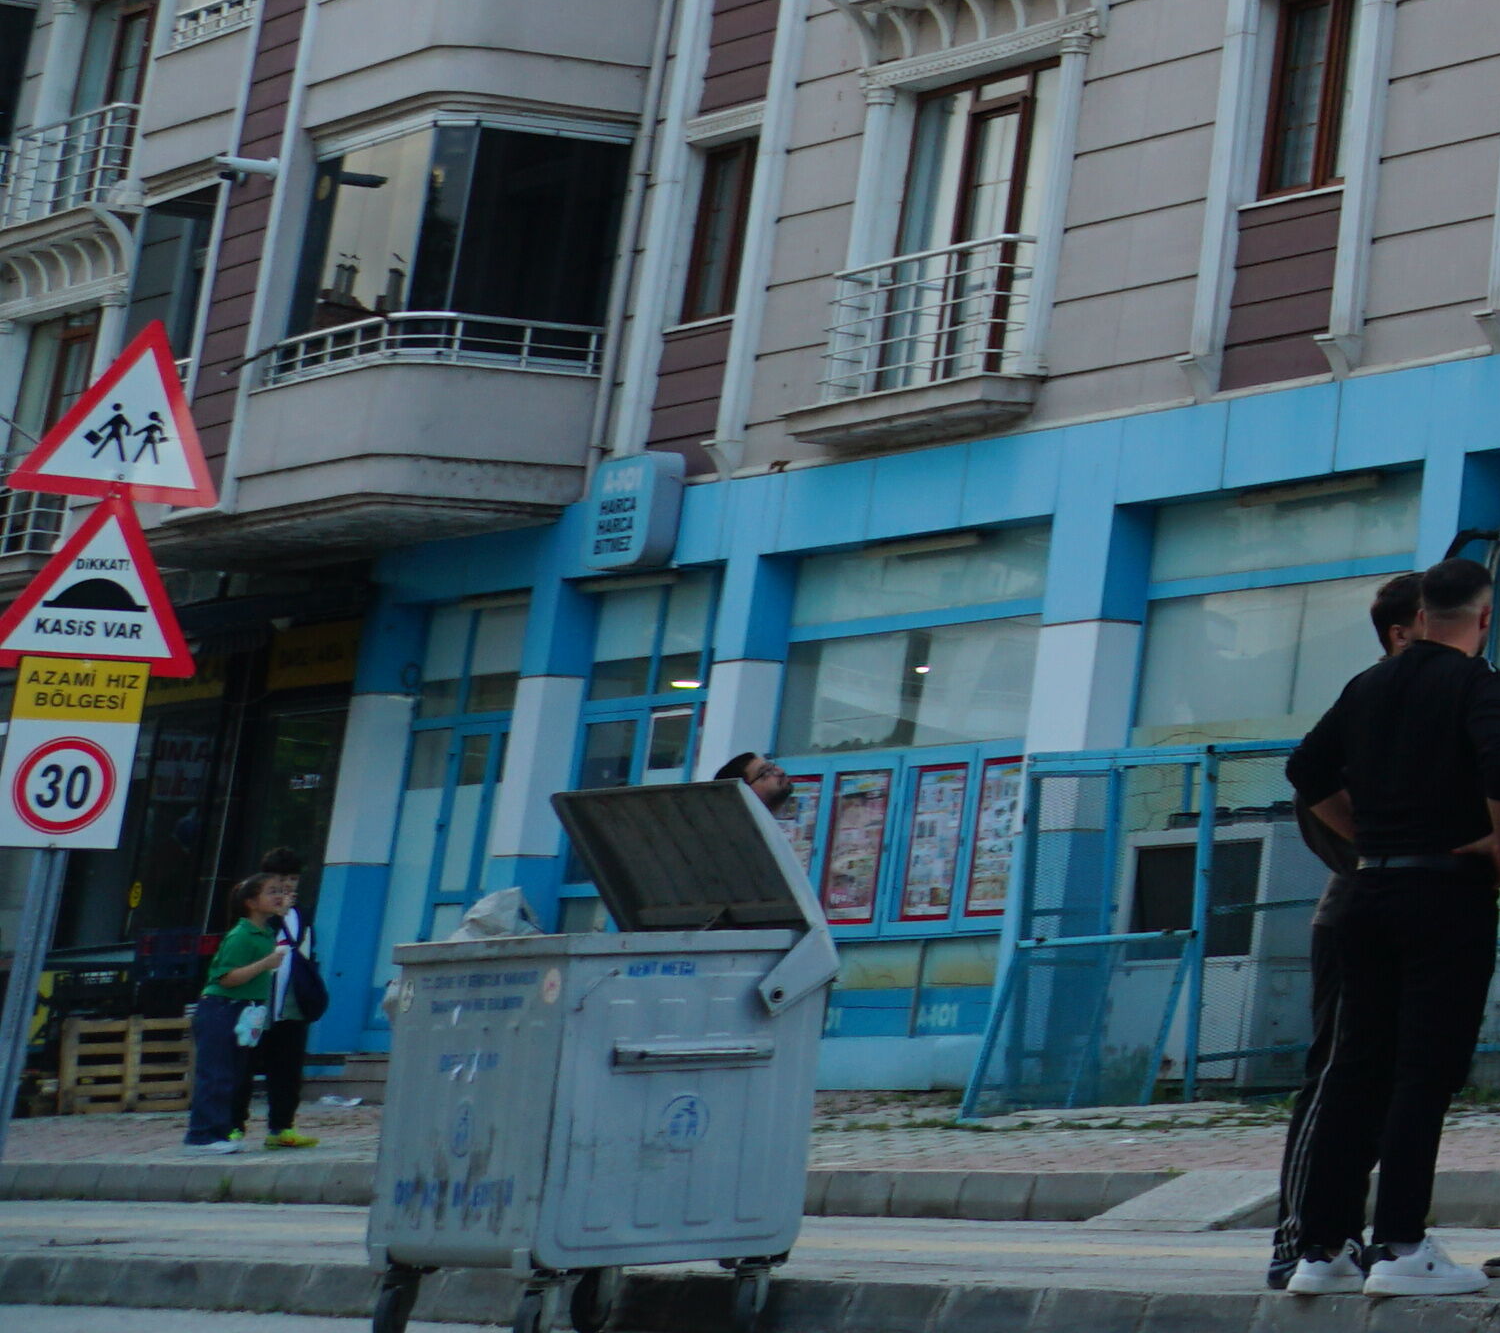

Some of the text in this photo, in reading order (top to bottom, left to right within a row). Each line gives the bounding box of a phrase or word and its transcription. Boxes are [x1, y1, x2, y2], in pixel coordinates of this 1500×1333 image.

[104, 622, 143, 639] VAR
[27, 670, 140, 689] AZAMİ HIZ
[34, 689, 126, 710] BÖLGESİ
[34, 763, 92, 810] 30
